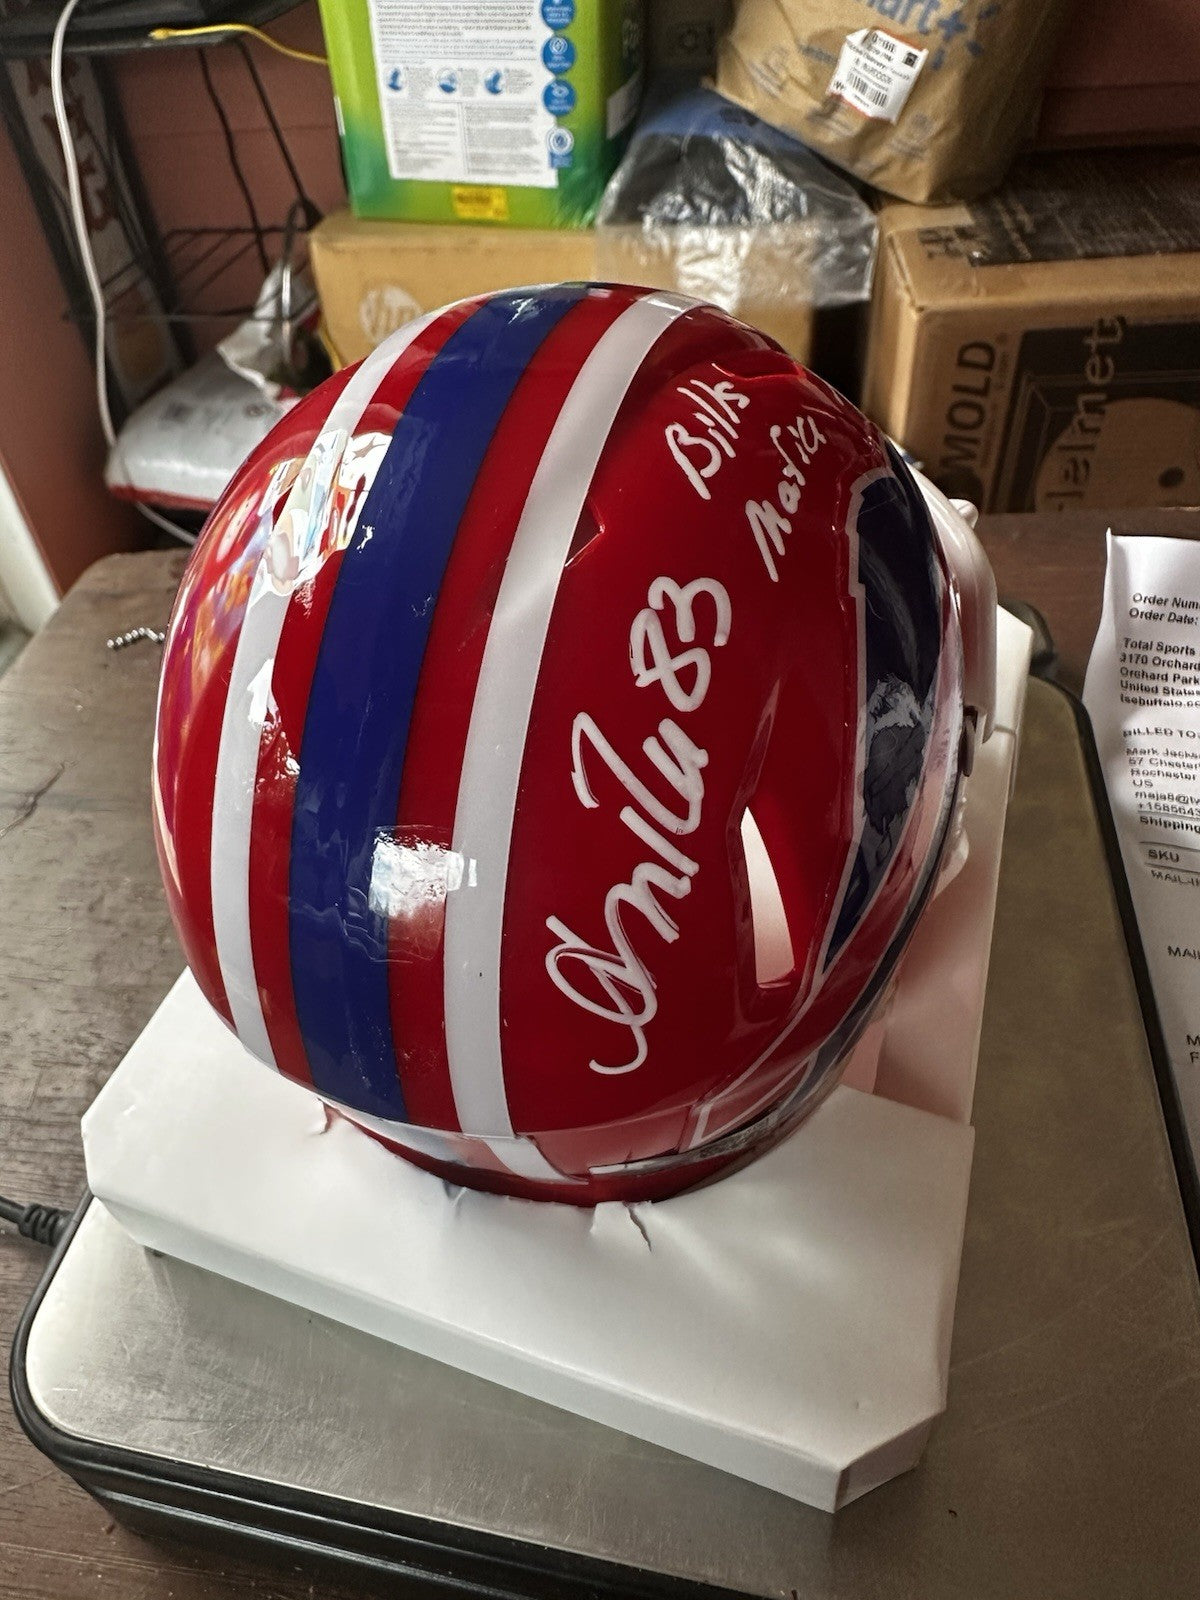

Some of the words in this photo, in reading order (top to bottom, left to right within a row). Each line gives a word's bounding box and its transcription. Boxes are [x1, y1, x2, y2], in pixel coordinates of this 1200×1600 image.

[665, 379, 750, 500] Bills
[1132, 592, 1169, 606] Order
[1171, 597, 1200, 610] Num
[1129, 607, 1165, 621] Order
[1167, 612, 1198, 625] Date:
[630, 576, 732, 712] 83
[1123, 637, 1153, 651] Total
[1156, 641, 1196, 656] Sports
[1120, 652, 1148, 665] 3170
[1120, 666, 1168, 682] Orchard
[1120, 680, 1159, 694] United
[1122, 727, 1173, 738] BILLED
[1126, 747, 1159, 757] Mark
[1130, 768, 1197, 781] Rochester
[1132, 779, 1154, 788] US
[1139, 816, 1200, 834] Shipping
[1147, 848, 1180, 864] SKU
